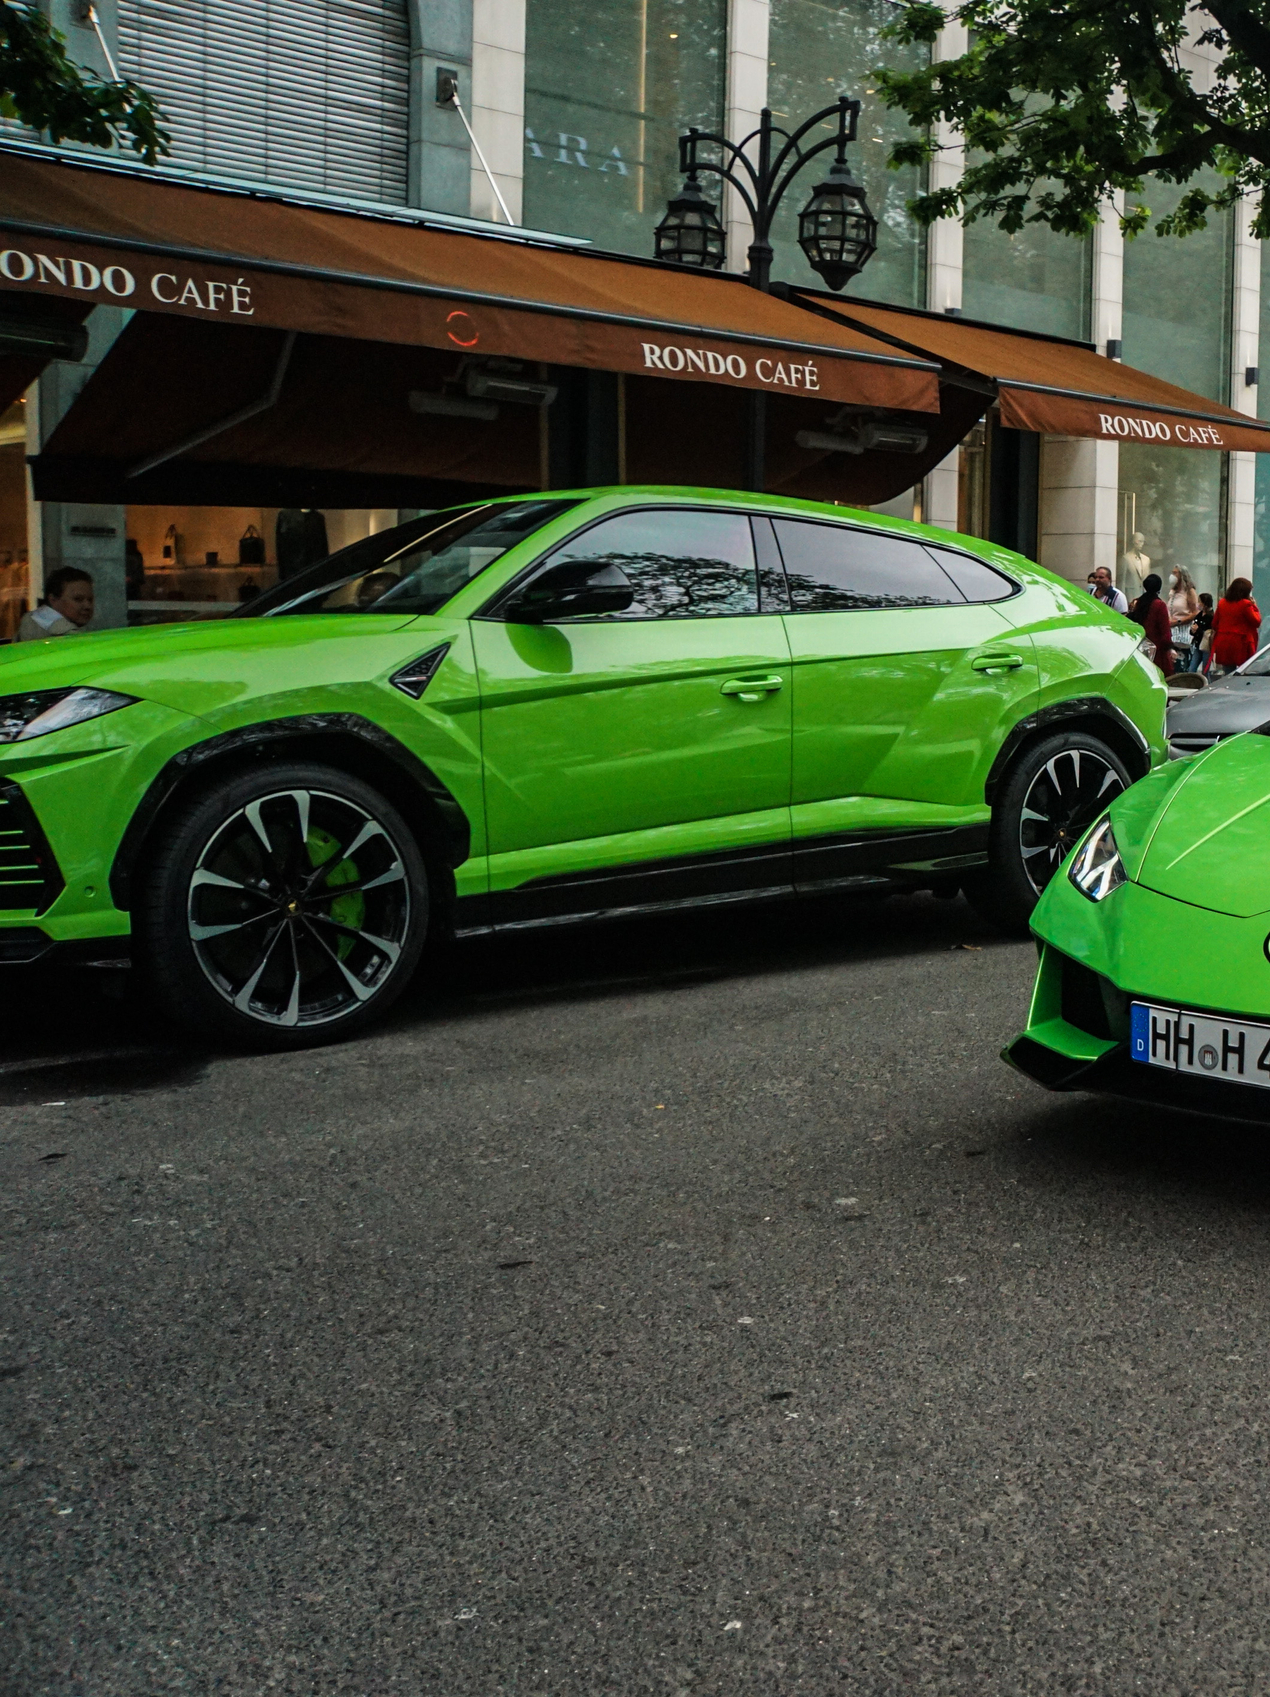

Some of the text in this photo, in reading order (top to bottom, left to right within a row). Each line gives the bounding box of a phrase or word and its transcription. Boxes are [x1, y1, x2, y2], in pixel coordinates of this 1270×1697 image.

[0, 250, 254, 315] ONDO CAFÉ
[641, 343, 820, 390] RONDO CAFÉ
[1098, 414, 1223, 445] RONDO CAFÉ
[1137, 1039, 1144, 1051] D
[1151, 1016, 1195, 1066] HH
[1221, 1028, 1246, 1075] H
